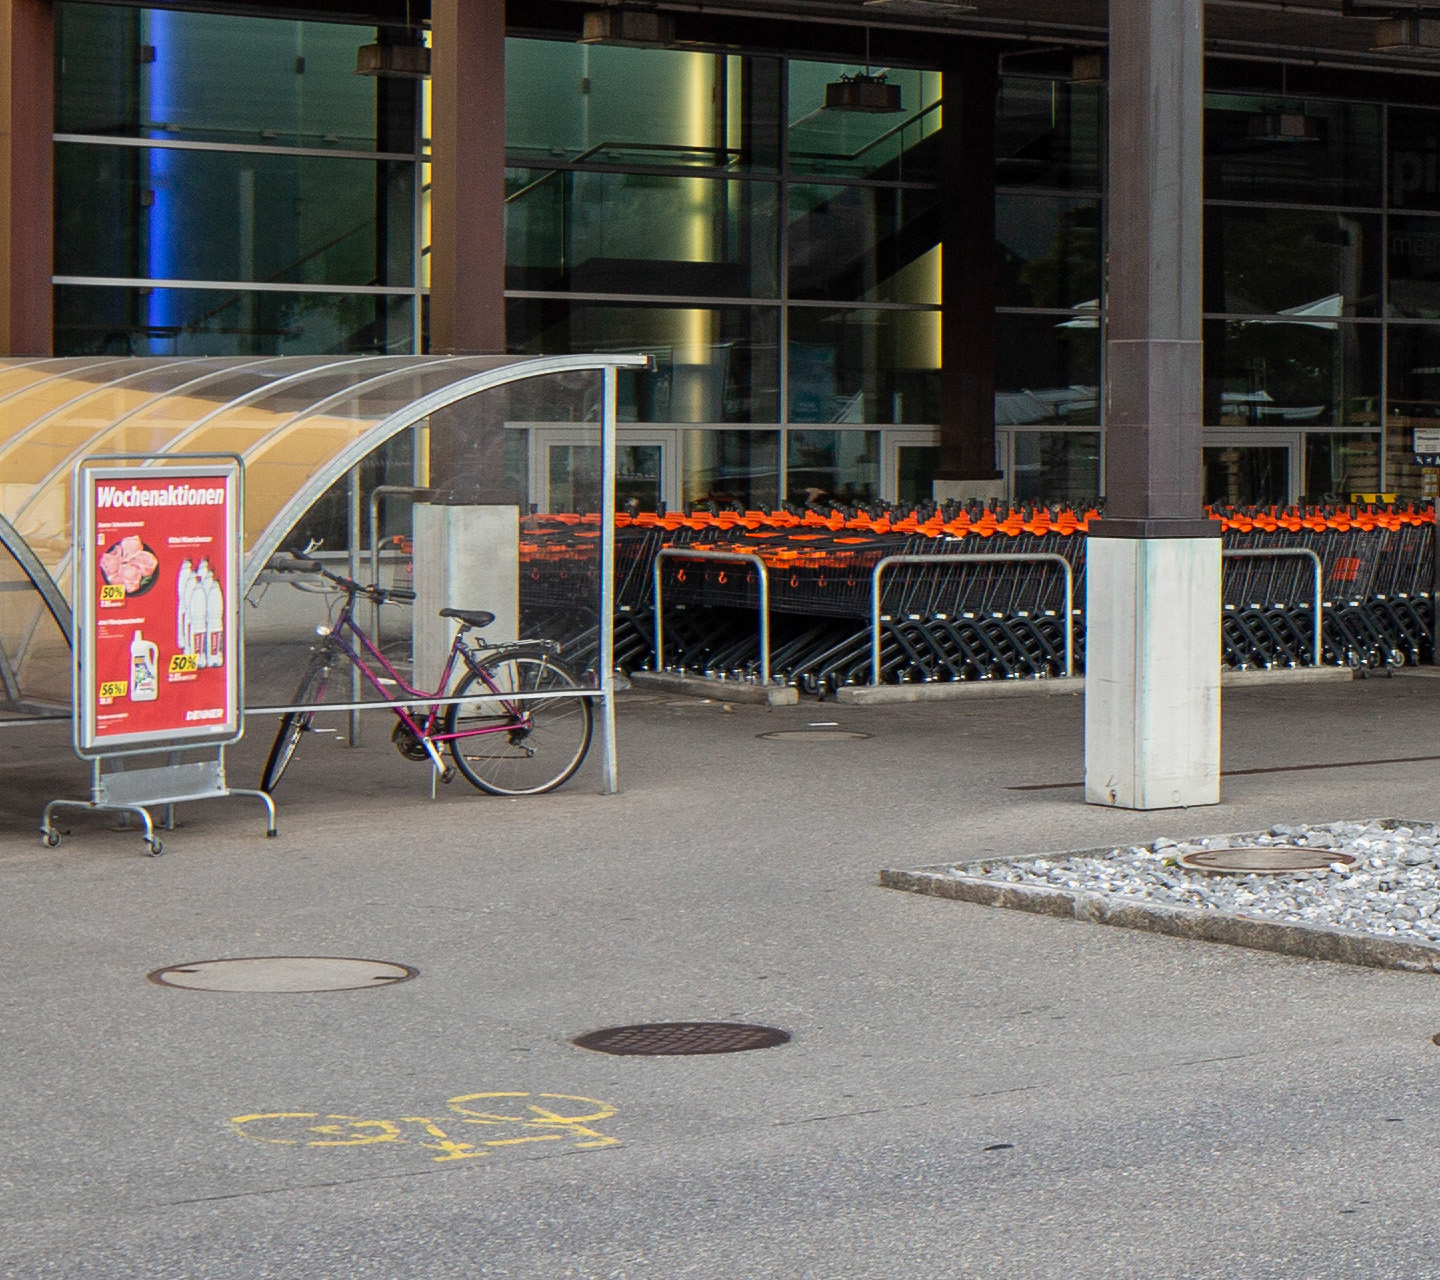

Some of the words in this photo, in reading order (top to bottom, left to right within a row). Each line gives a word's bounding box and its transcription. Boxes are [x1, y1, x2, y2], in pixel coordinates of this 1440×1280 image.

[97, 484, 225, 508] Wochenaktionen
[102, 585, 123, 598] 50%
[171, 656, 198, 671] 50%
